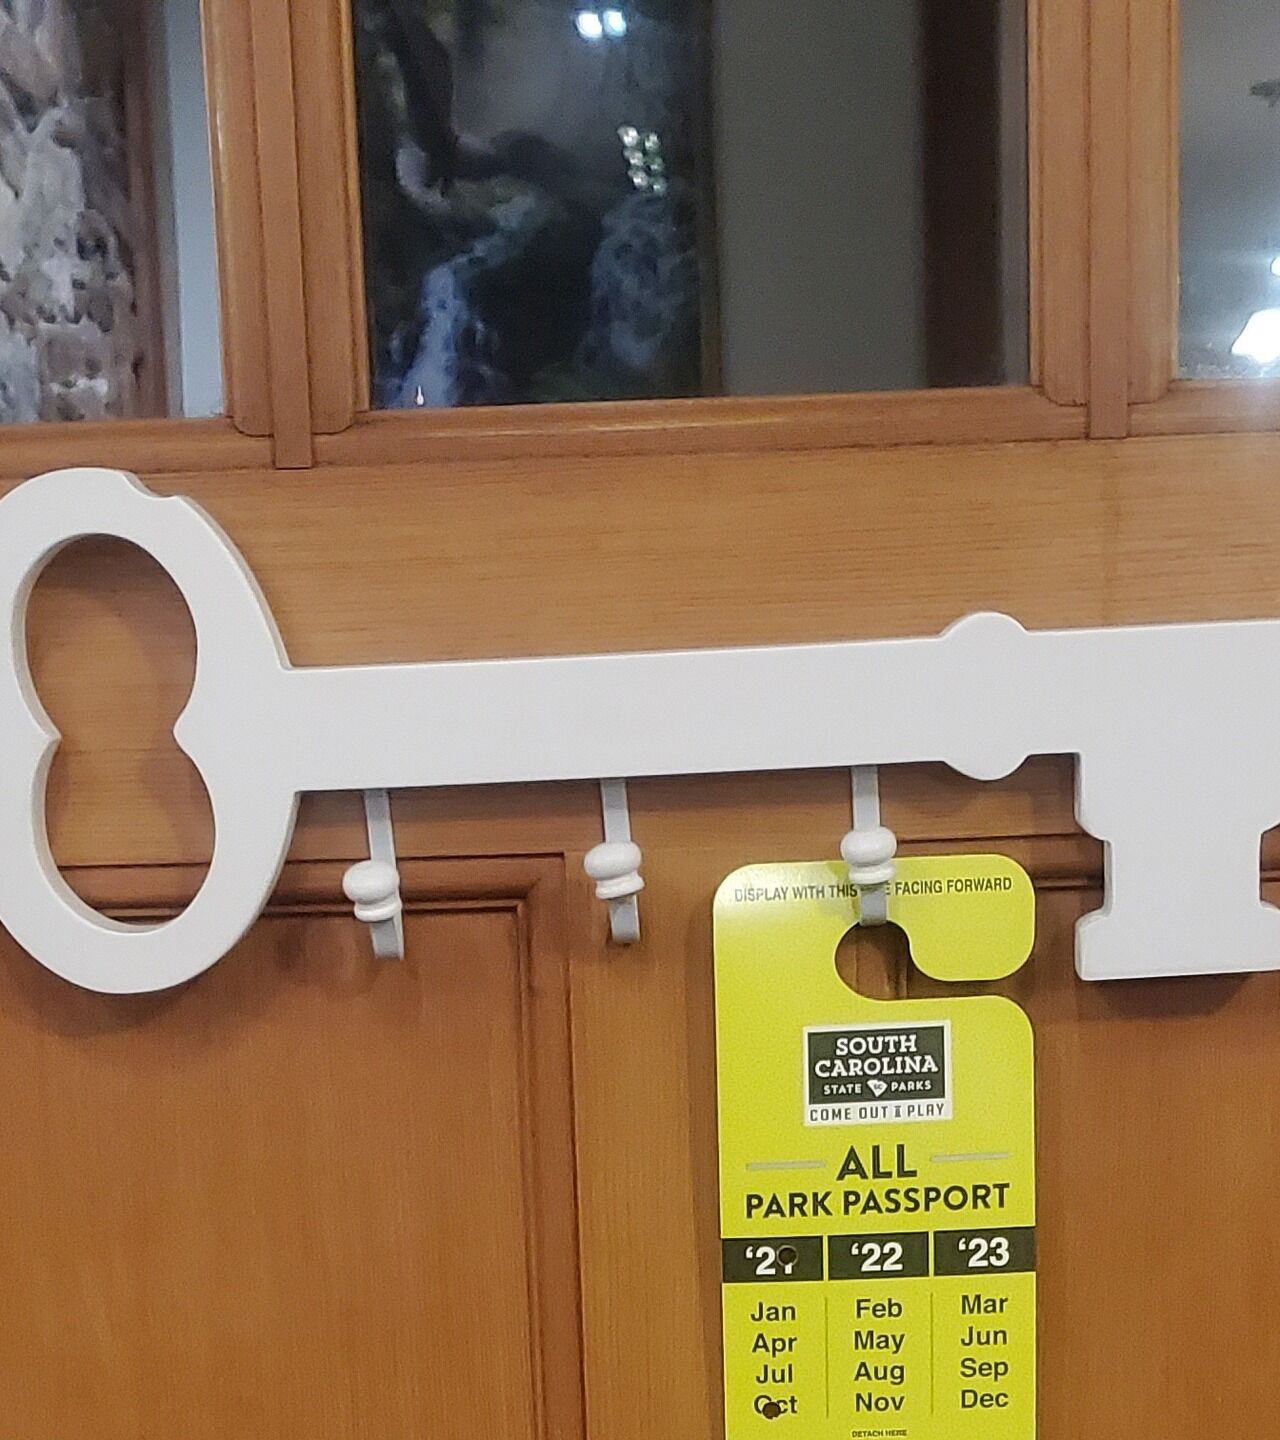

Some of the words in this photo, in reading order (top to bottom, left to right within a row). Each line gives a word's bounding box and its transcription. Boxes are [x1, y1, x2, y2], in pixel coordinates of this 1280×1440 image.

[734, 886, 789, 902] DISPLAY
[791, 884, 825, 899] WITH
[829, 883, 858, 897] THIS
[895, 880, 942, 895] FACING
[947, 877, 1012, 893] FORWARD
[835, 1034, 917, 1056] SOUTH
[815, 1055, 938, 1077] CAROLINA
[823, 1083, 862, 1095] STATE
[891, 1080, 932, 1092] PARKS
[810, 1107, 851, 1121] COME
[858, 1105, 888, 1119] OUT
[907, 1103, 944, 1117] PLAY
[836, 1143, 918, 1181] ALL
[745, 1191, 833, 1219] PARK
[843, 1182, 1010, 1216] PASSPORT
[750, 1302, 796, 1322] Jan
[856, 1298, 902, 1318] Feb
[961, 1294, 1008, 1314] Mar
[752, 1333, 797, 1357] Apr
[854, 1330, 905, 1354] May
[961, 1326, 1007, 1346] Jun
[755, 1364, 793, 1383] Jul
[854, 1361, 905, 1385] Aug
[960, 1357, 1009, 1382] Sep
[855, 1392, 905, 1412] Nov
[961, 1389, 1009, 1409] Dec
[851, 1430, 883, 1438] DETACH
[885, 1429, 907, 1437] HERE
